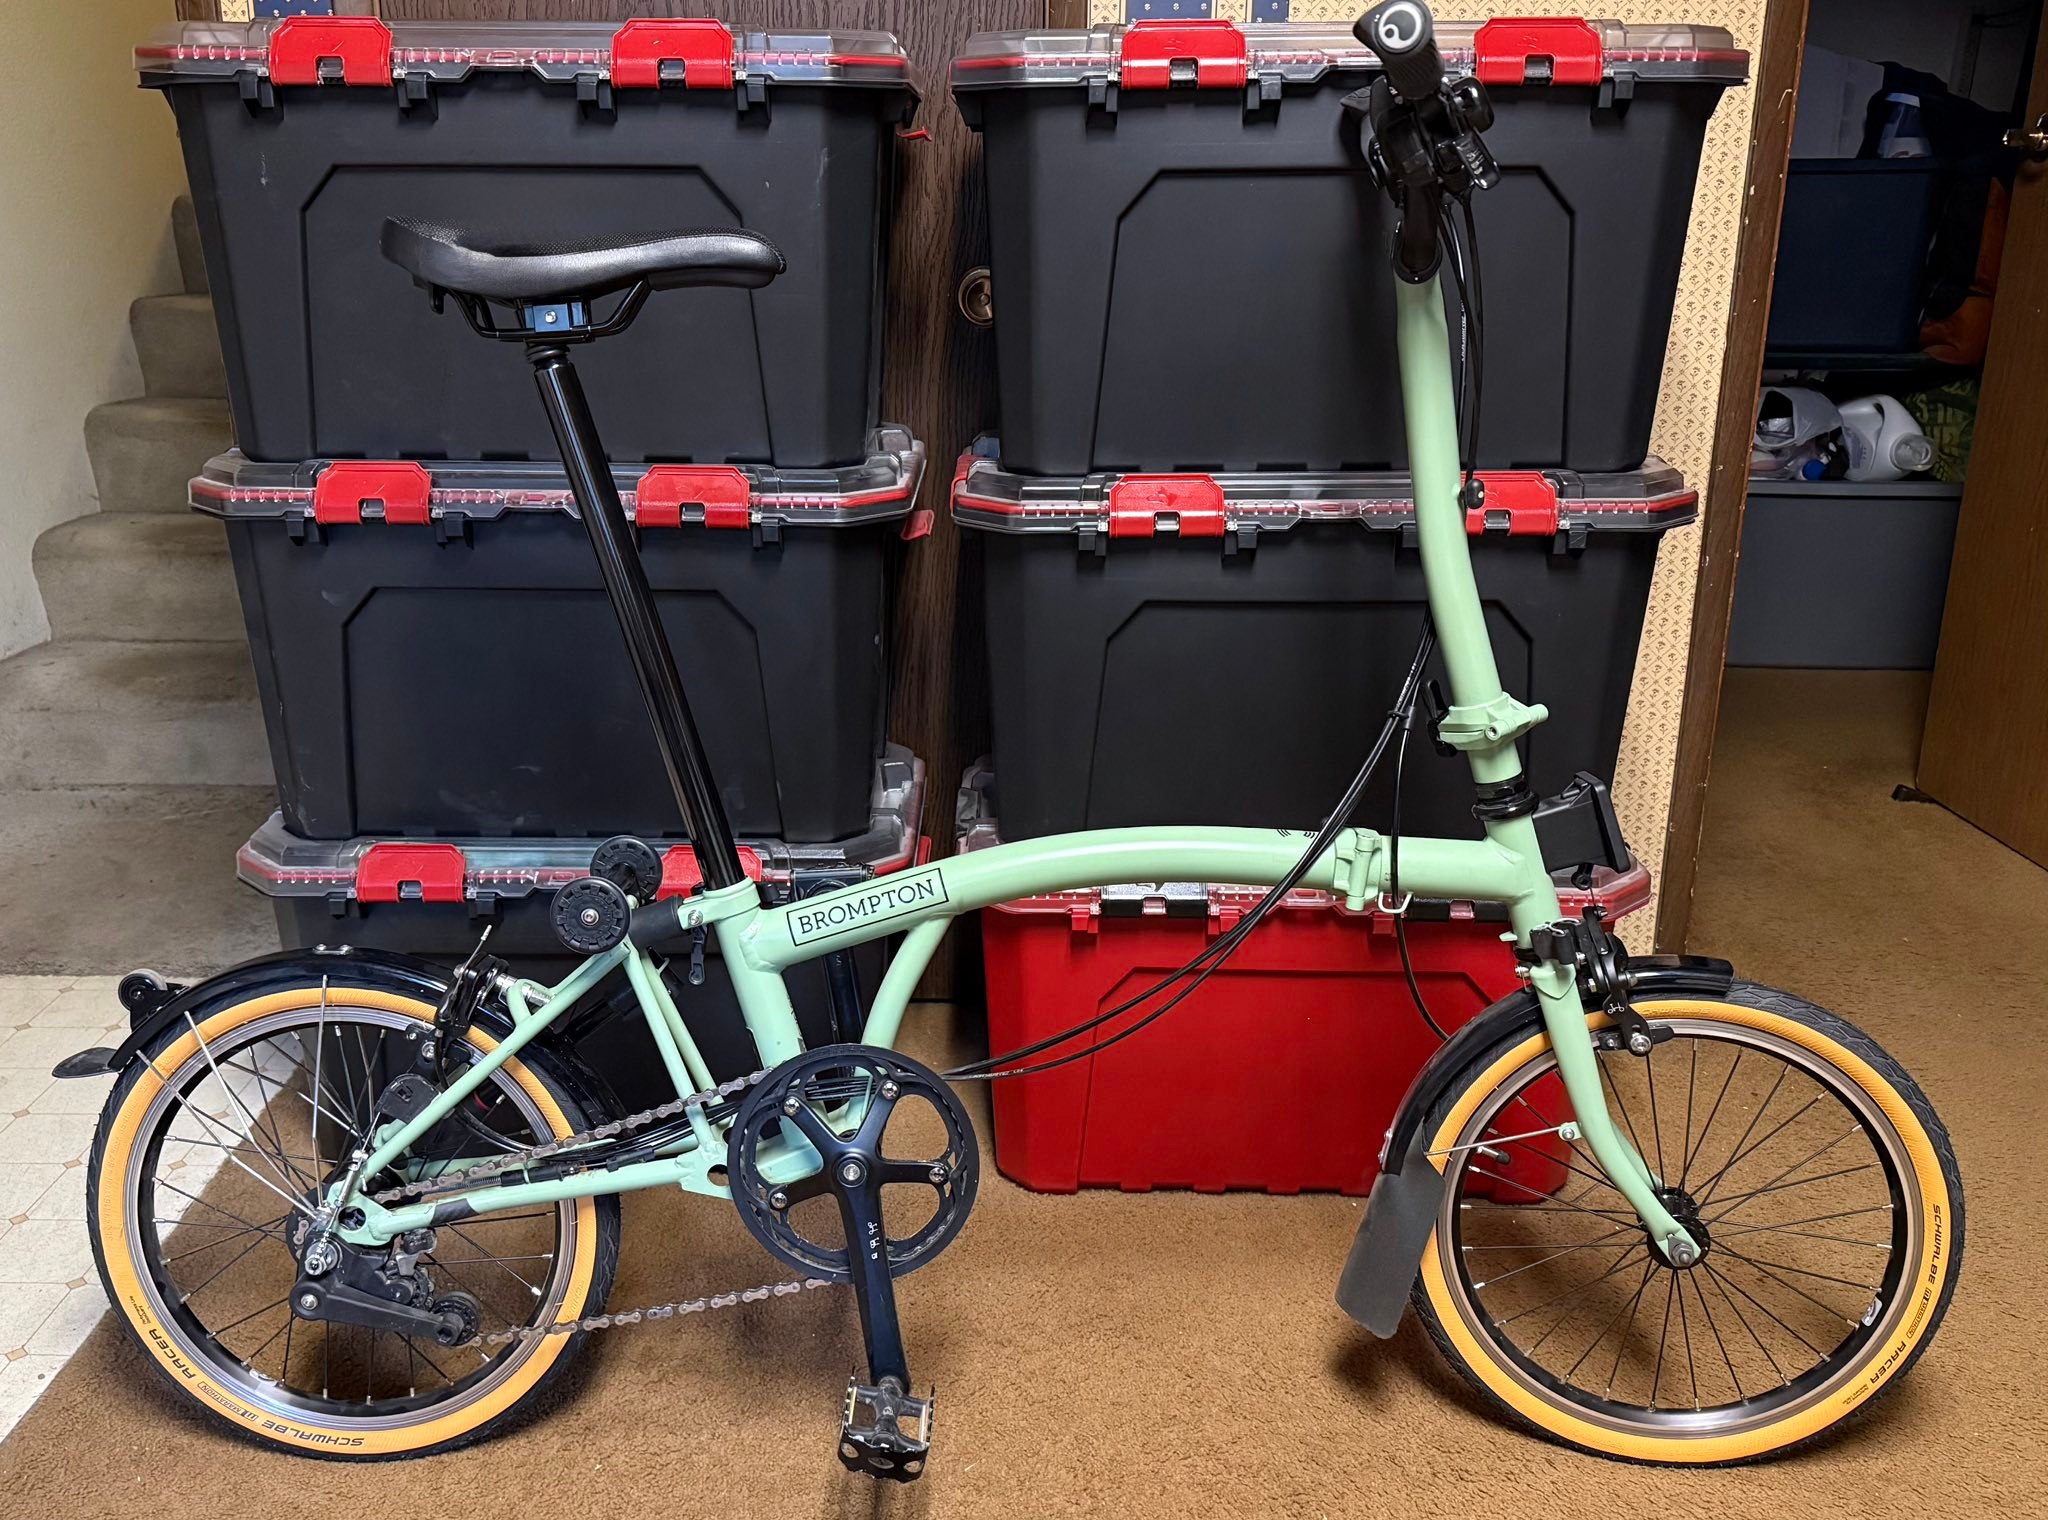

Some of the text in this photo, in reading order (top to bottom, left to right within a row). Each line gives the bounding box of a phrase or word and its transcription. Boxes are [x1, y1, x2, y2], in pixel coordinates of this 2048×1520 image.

[798, 879, 935, 934] BROMPTON
[1928, 1204, 1943, 1285] SCHWALBE
[149, 1329, 196, 1379] RACER
[1870, 1341, 1907, 1385] RACER
[201, 1385, 242, 1412] MARATHON
[262, 1420, 365, 1446] SCHWALBE
